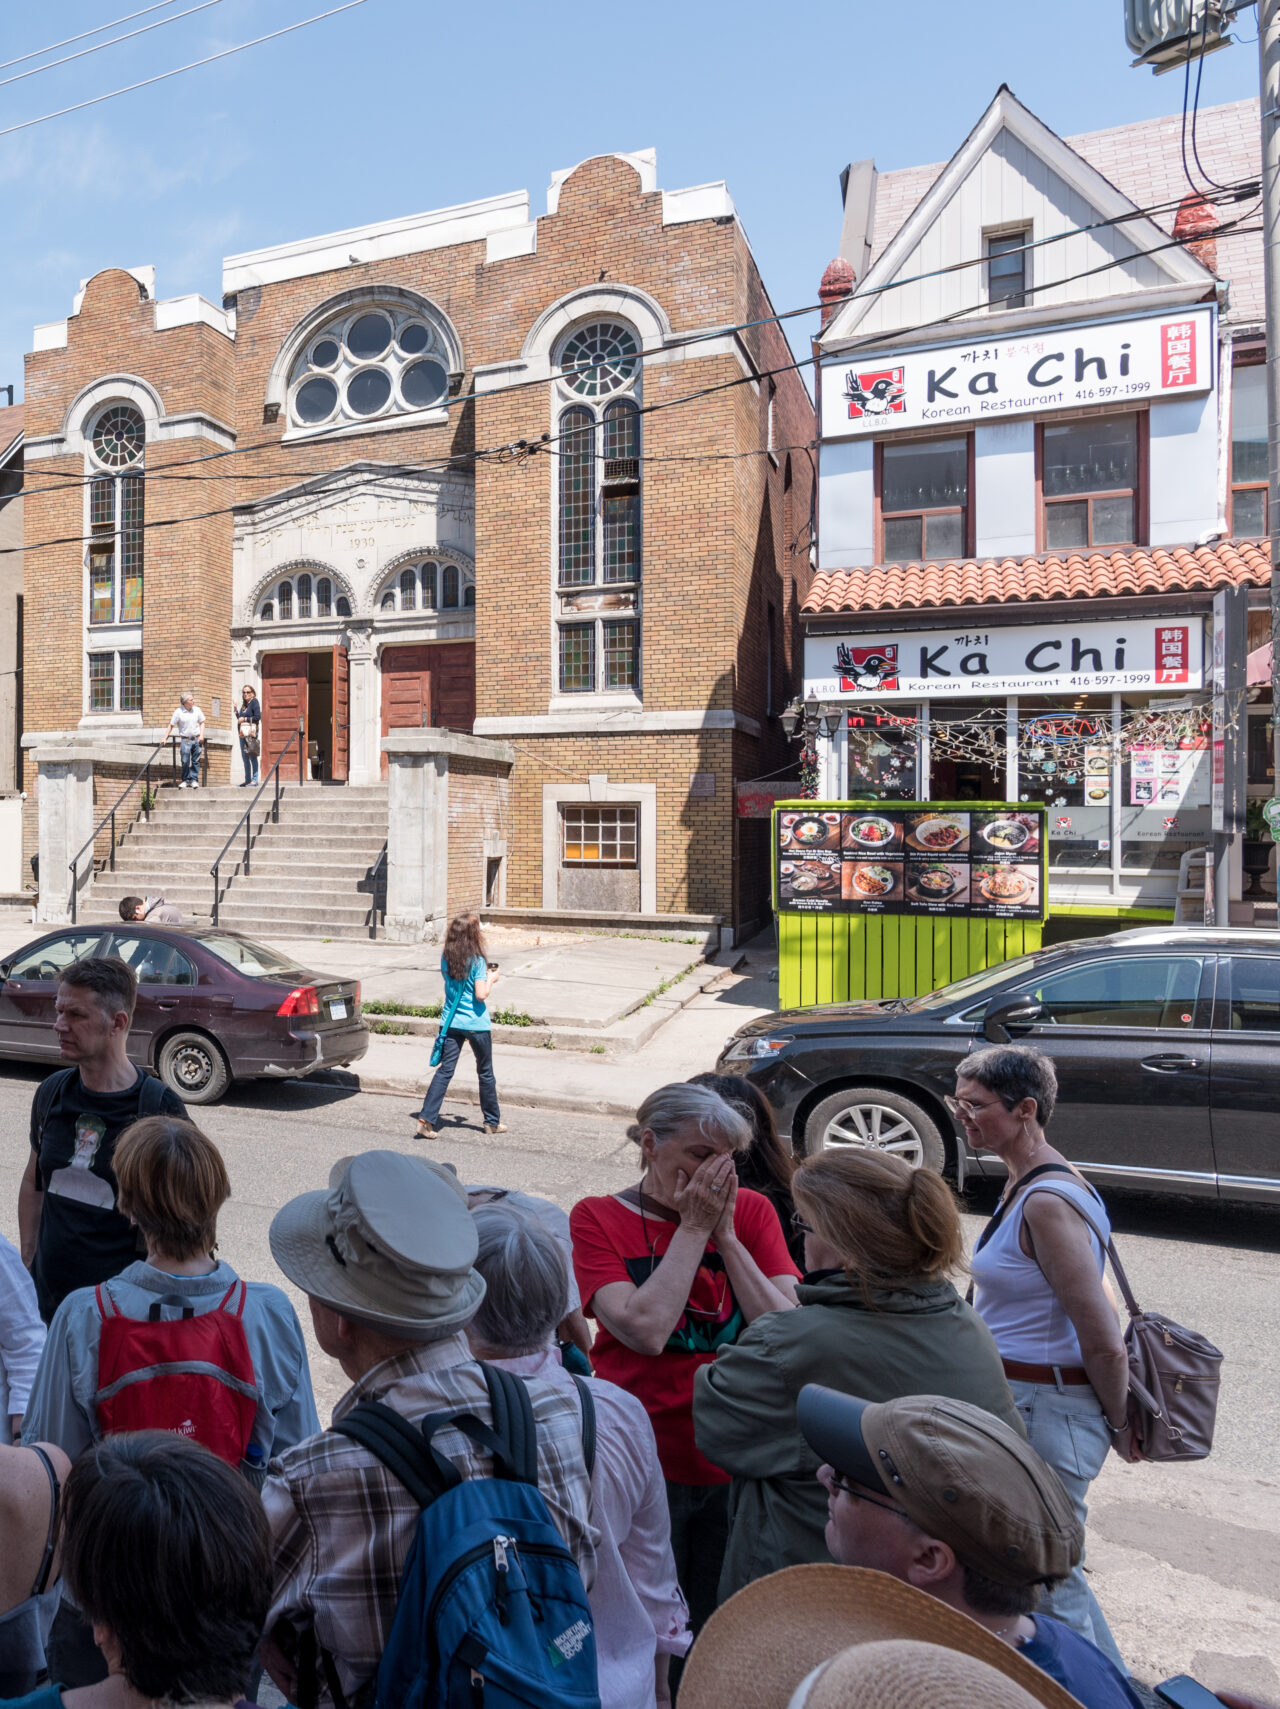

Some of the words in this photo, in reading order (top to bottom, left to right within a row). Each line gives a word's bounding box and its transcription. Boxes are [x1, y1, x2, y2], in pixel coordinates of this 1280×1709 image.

[1166, 323, 1192, 386] 韩国餐厅
[927, 366, 999, 403] Ka
[1027, 343, 1131, 387] Chi
[922, 405, 971, 420] Korean
[980, 391, 1064, 412] Restaurant
[350, 536, 376, 550] 1930
[920, 645, 990, 679] Ka
[1025, 637, 1127, 673] Chi
[1161, 629, 1184, 682] 韩国餐厅
[908, 682, 961, 691] Korean
[971, 679, 1060, 690] Restaurant
[554, 1618, 587, 1649] MOUNTAIN
[560, 1623, 592, 1653] EQUIPMENT
[564, 1640, 583, 1660] CO-OP
